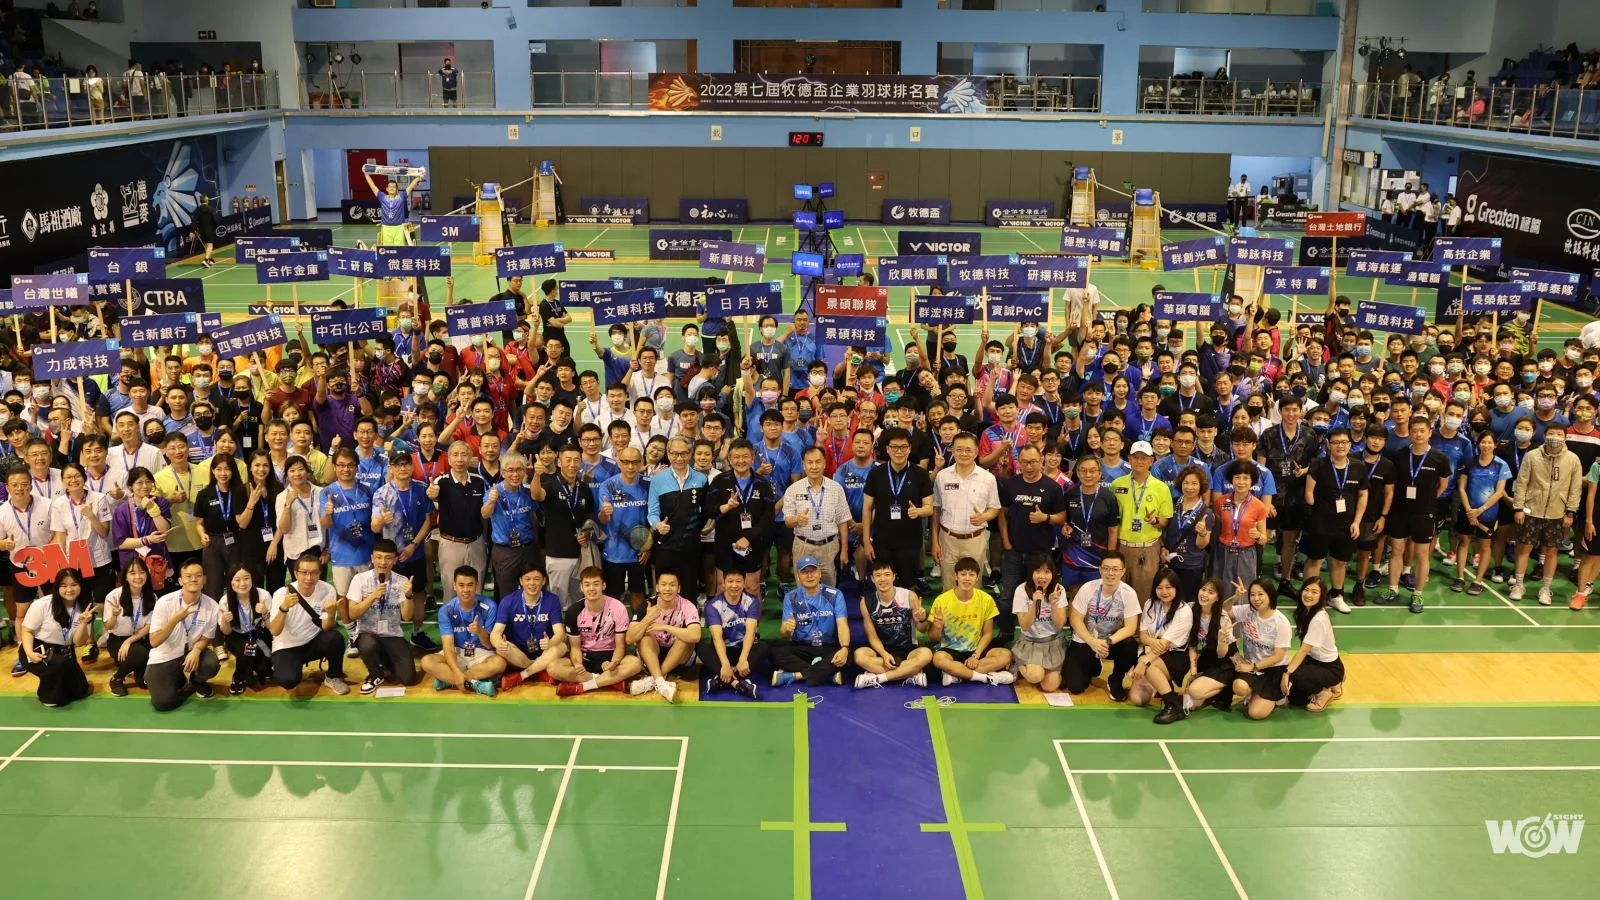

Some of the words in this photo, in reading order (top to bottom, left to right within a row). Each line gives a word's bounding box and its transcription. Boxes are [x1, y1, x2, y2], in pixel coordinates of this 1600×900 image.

[1478, 201, 1520, 230] Greaten
[442, 226, 459, 237] 3M
[1309, 222, 1362, 232] 台灣土地銀行
[925, 242, 970, 252] VICTOR
[708, 252, 755, 268] 新唐科技
[1443, 249, 1490, 260] 高技企業
[266, 264, 319, 277] 合作金庫
[337, 258, 374, 273] 工研院
[388, 258, 441, 271] 微星科技
[506, 256, 556, 272] 技嘉科技
[1356, 261, 1402, 274] 萬海航運
[888, 268, 938, 280] 欣興桃園
[960, 268, 1010, 281] 牧德科技
[1406, 272, 1441, 284] 通電腦
[1276, 278, 1318, 290] 英特爾
[144, 290, 188, 306] CTBA
[721, 296, 768, 310] 日月光
[1472, 294, 1521, 306] 長榮航空
[992, 305, 1042, 316] 資誠PwC
[1163, 304, 1211, 316] 華碩電腦
[457, 313, 508, 330] 惠普科技
[1365, 313, 1414, 329] 聯發科技
[132, 326, 187, 342] 台新銀行
[316, 320, 384, 338] 中石化公司
[825, 328, 876, 341] 景碩科技
[218, 327, 284, 354] 四零四科技
[46, 354, 109, 372] 力成科技
[14, 540, 95, 588] 3M
